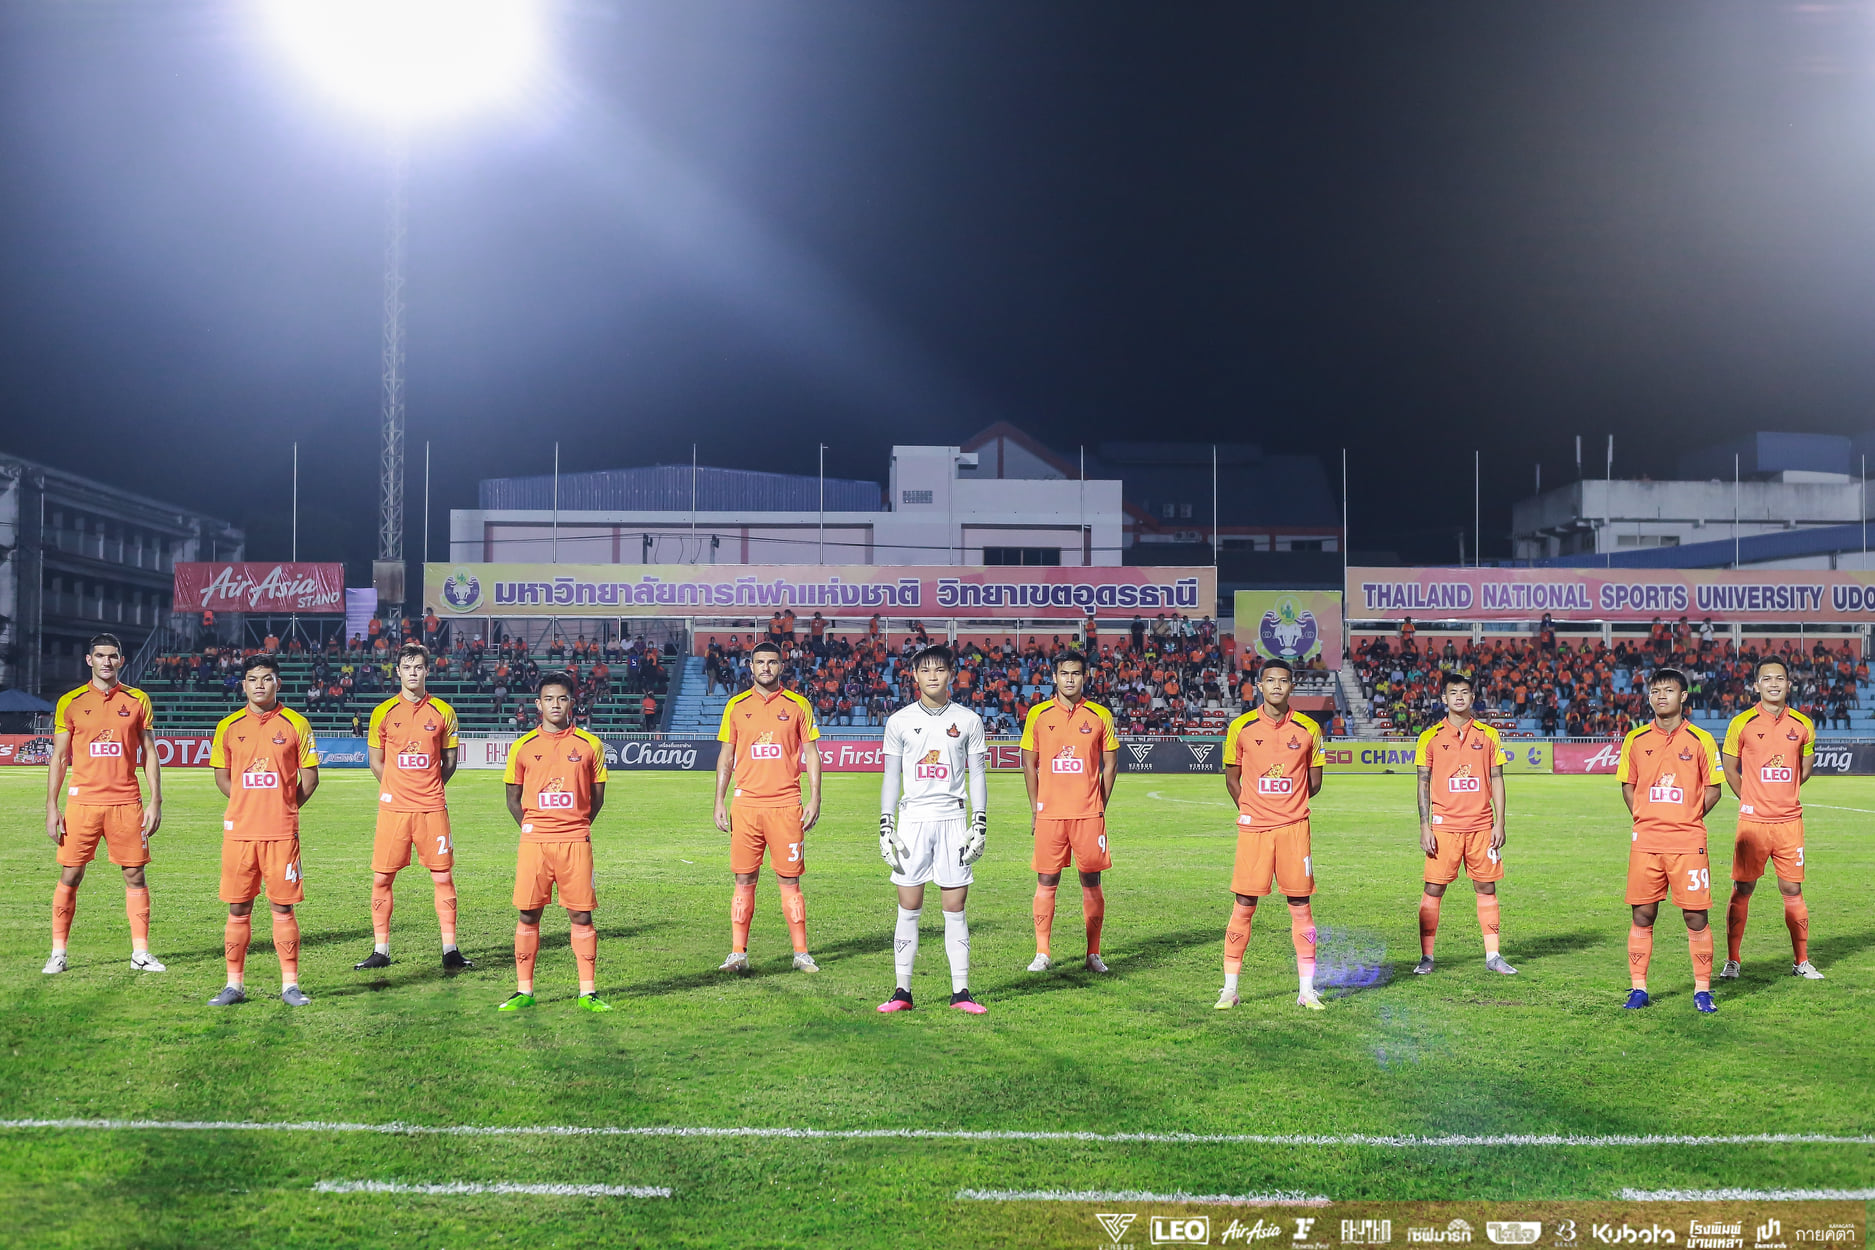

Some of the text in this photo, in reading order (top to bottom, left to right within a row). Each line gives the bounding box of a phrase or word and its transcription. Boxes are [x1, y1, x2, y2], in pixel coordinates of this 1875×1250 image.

[298, 591, 340, 608] STAND
[495, 576, 1198, 614] มหาวิทยาลัยการกีฬาแห่งชาติ วิทยาเขตอุดรธานี
[1362, 582, 1473, 610] THAILAND
[1482, 582, 1592, 611] NATIONAL
[1600, 583, 1688, 612] SPORTS
[1697, 583, 1824, 613] UNIVERSITY
[92, 743, 120, 755] LEO
[621, 742, 697, 769] Chang
[753, 746, 780, 757] LEO
[839, 745, 883, 766] First
[400, 755, 428, 767] LEO
[1361, 750, 1415, 764] CHAM
[918, 765, 948, 779] LEO
[1054, 760, 1082, 772] LEO
[245, 774, 276, 787] LEO
[1762, 769, 1790, 781] LEO
[1261, 780, 1290, 793] LEO
[1450, 779, 1478, 791] LEO
[541, 794, 571, 807] LEO
[1652, 788, 1681, 802] LEO
[1687, 868, 1709, 891] 39
